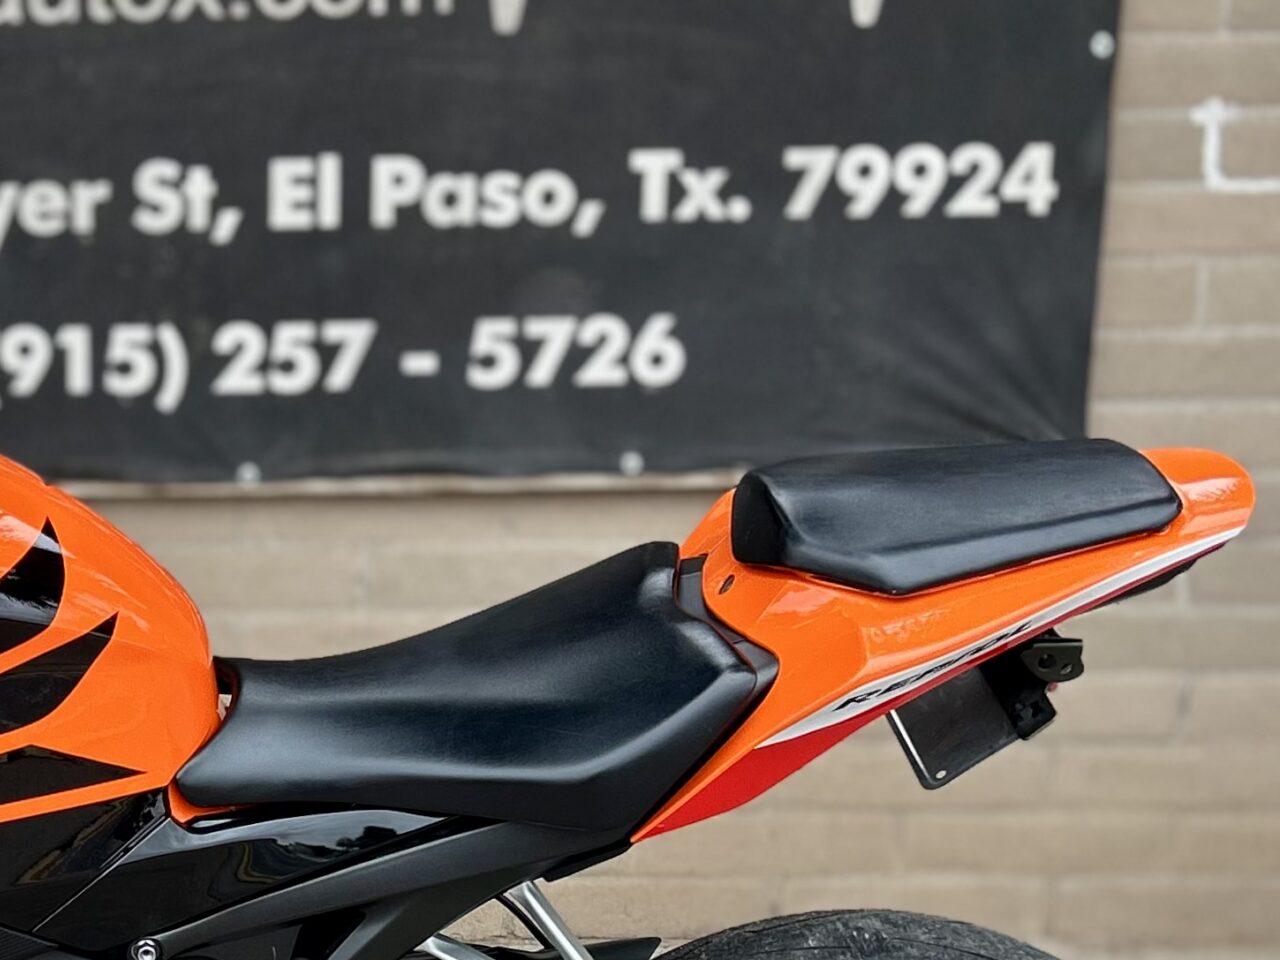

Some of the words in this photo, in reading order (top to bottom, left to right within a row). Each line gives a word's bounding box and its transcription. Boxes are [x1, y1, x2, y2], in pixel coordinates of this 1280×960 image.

[131, 157, 242, 246] St,
[266, 151, 342, 232] El
[369, 153, 605, 239] Paso,
[628, 147, 753, 224] Tx.
[782, 141, 1060, 222] 79924
[212, 319, 377, 396] 257
[400, 351, 440, 376] -
[466, 312, 687, 391] 5726
